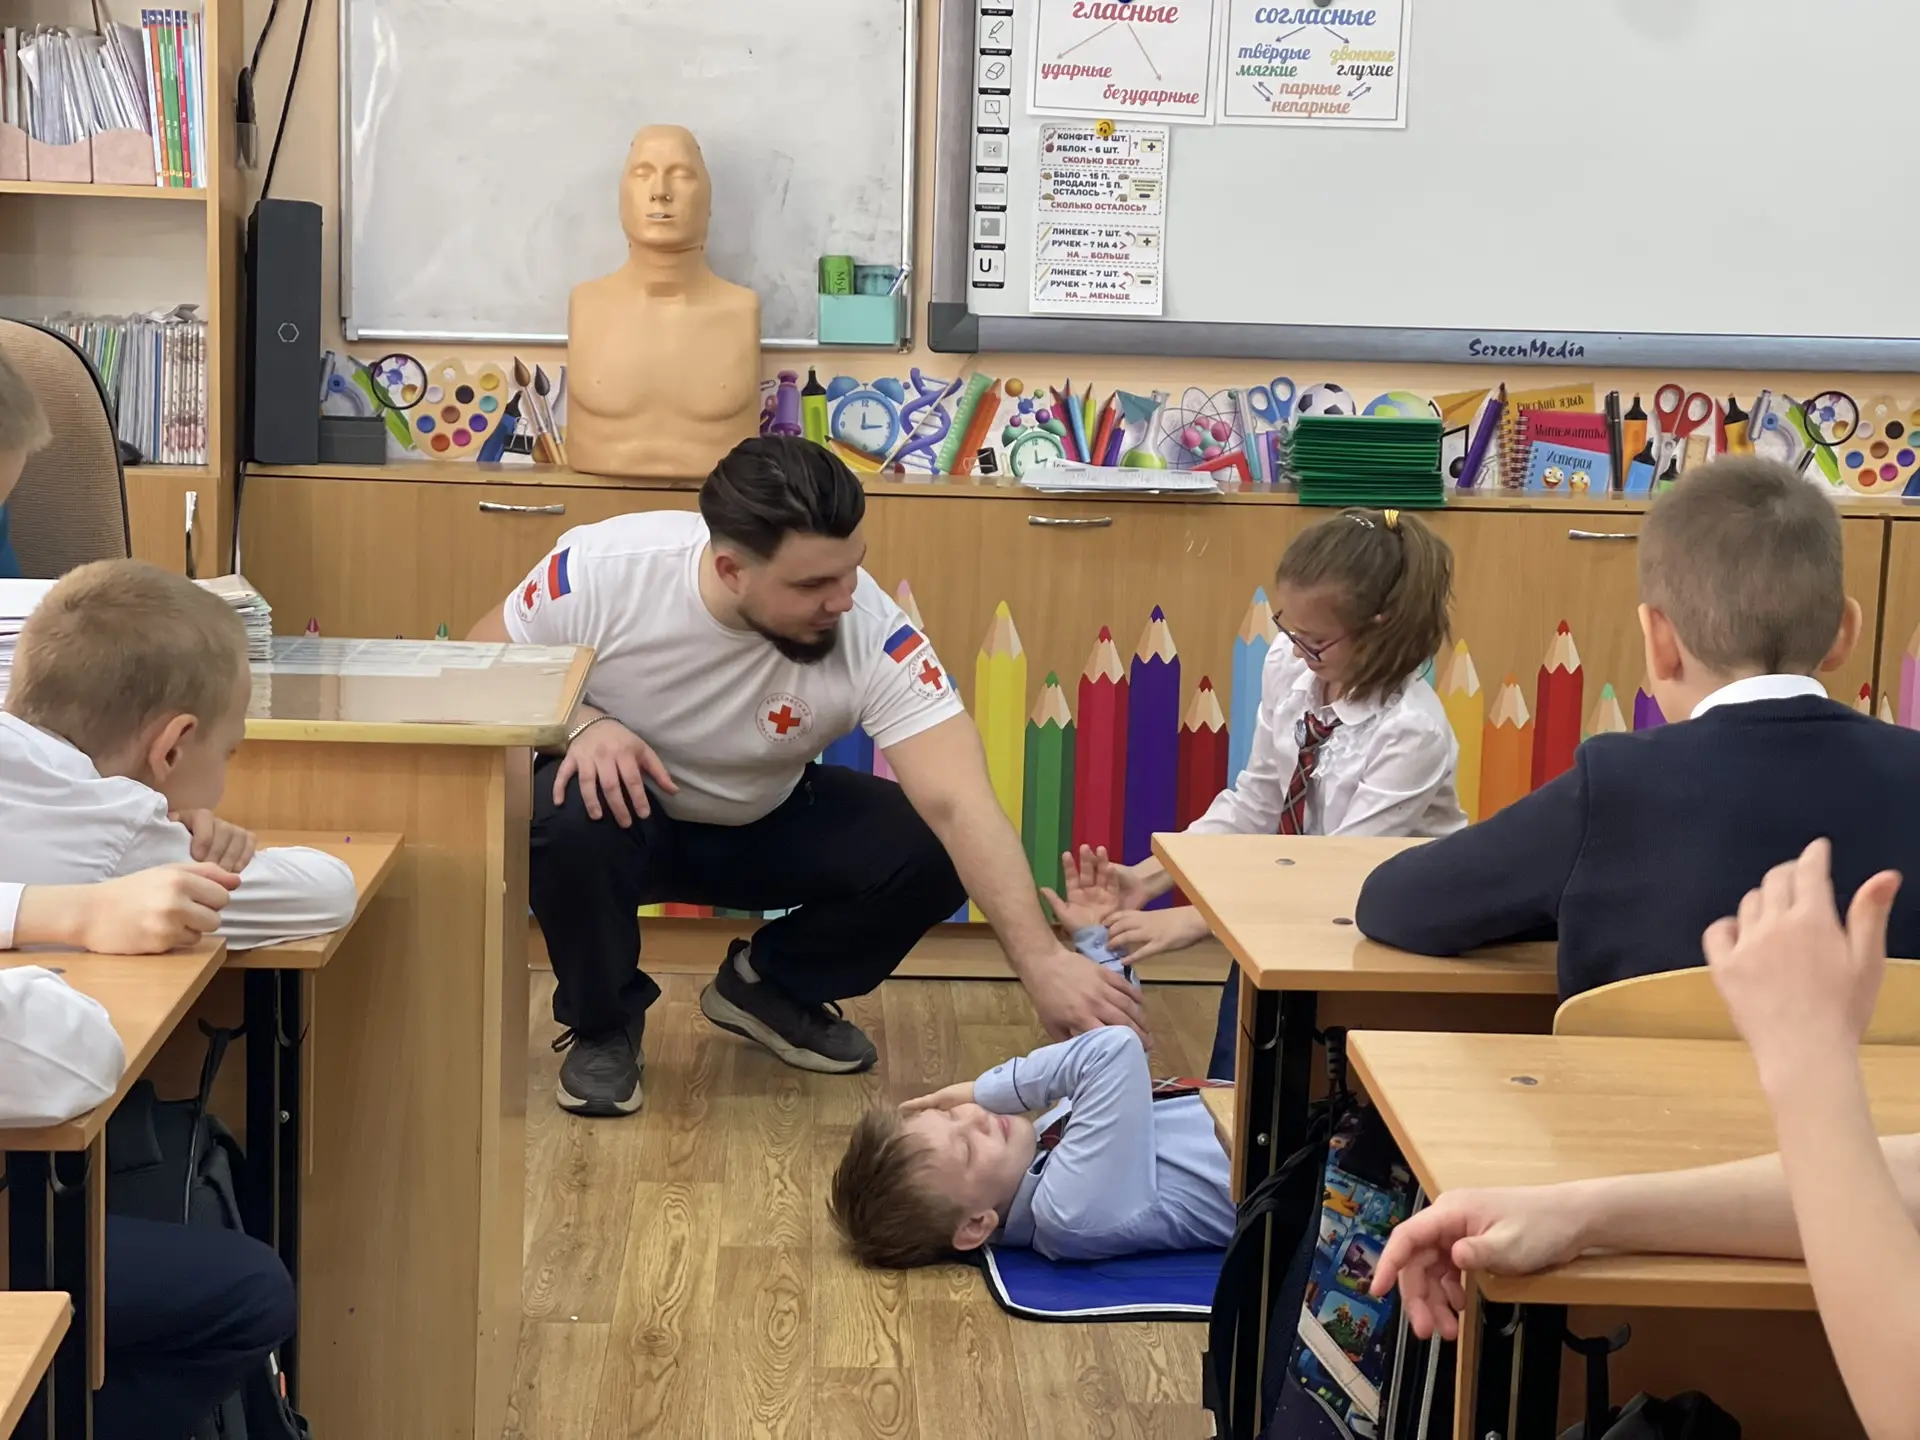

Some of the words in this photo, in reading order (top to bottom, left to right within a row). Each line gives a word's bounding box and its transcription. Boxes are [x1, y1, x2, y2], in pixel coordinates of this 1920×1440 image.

[1073, 1, 1178, 23] гласные
[1255, 7, 1376, 26] согласные
[1238, 43, 1310, 64] твёрдые
[1330, 45, 1396, 65] звонкие
[1041, 63, 1112, 80] ударные
[1236, 64, 1298, 77] мягкие
[1337, 64, 1394, 81] глухие
[1103, 84, 1199, 106] безударные
[1280, 82, 1341, 99] парные
[1271, 99, 1351, 117] непарные
[1057, 133, 1093, 141] КОНФЕТ
[1056, 145, 1086, 153] ЯБЛОК
[1062, 156, 1104, 164] СКОЛЬКО
[1106, 157, 1140, 166] ВСЕГО?
[1054, 171, 1080, 179] БЫЛО
[1053, 180, 1097, 188] ПРОДАЛИ
[1053, 189, 1100, 197] ОСТАЛОСЬ
[1051, 201, 1092, 210] СКОЛЬКО
[1095, 203, 1147, 212] ОСТАЛОСЬ?
[1052, 228, 1089, 236] ЛИНЕЕК
[1052, 240, 1081, 248] РУЧЕК
[1067, 251, 1080, 259] НА
[1091, 252, 1130, 260] БОЛЬШЕ
[1050, 268, 1087, 277] ЛИНЕЕК
[1103, 270, 1120, 278] ШТ.
[1050, 280, 1079, 288] РУЧЕК
[1066, 291, 1078, 299] НА
[1089, 292, 1130, 300] МЕНЬШЕ
[1469, 338, 1585, 359] ScreenMedia
[1559, 395, 1584, 409] язык
[1546, 450, 1592, 470] История
